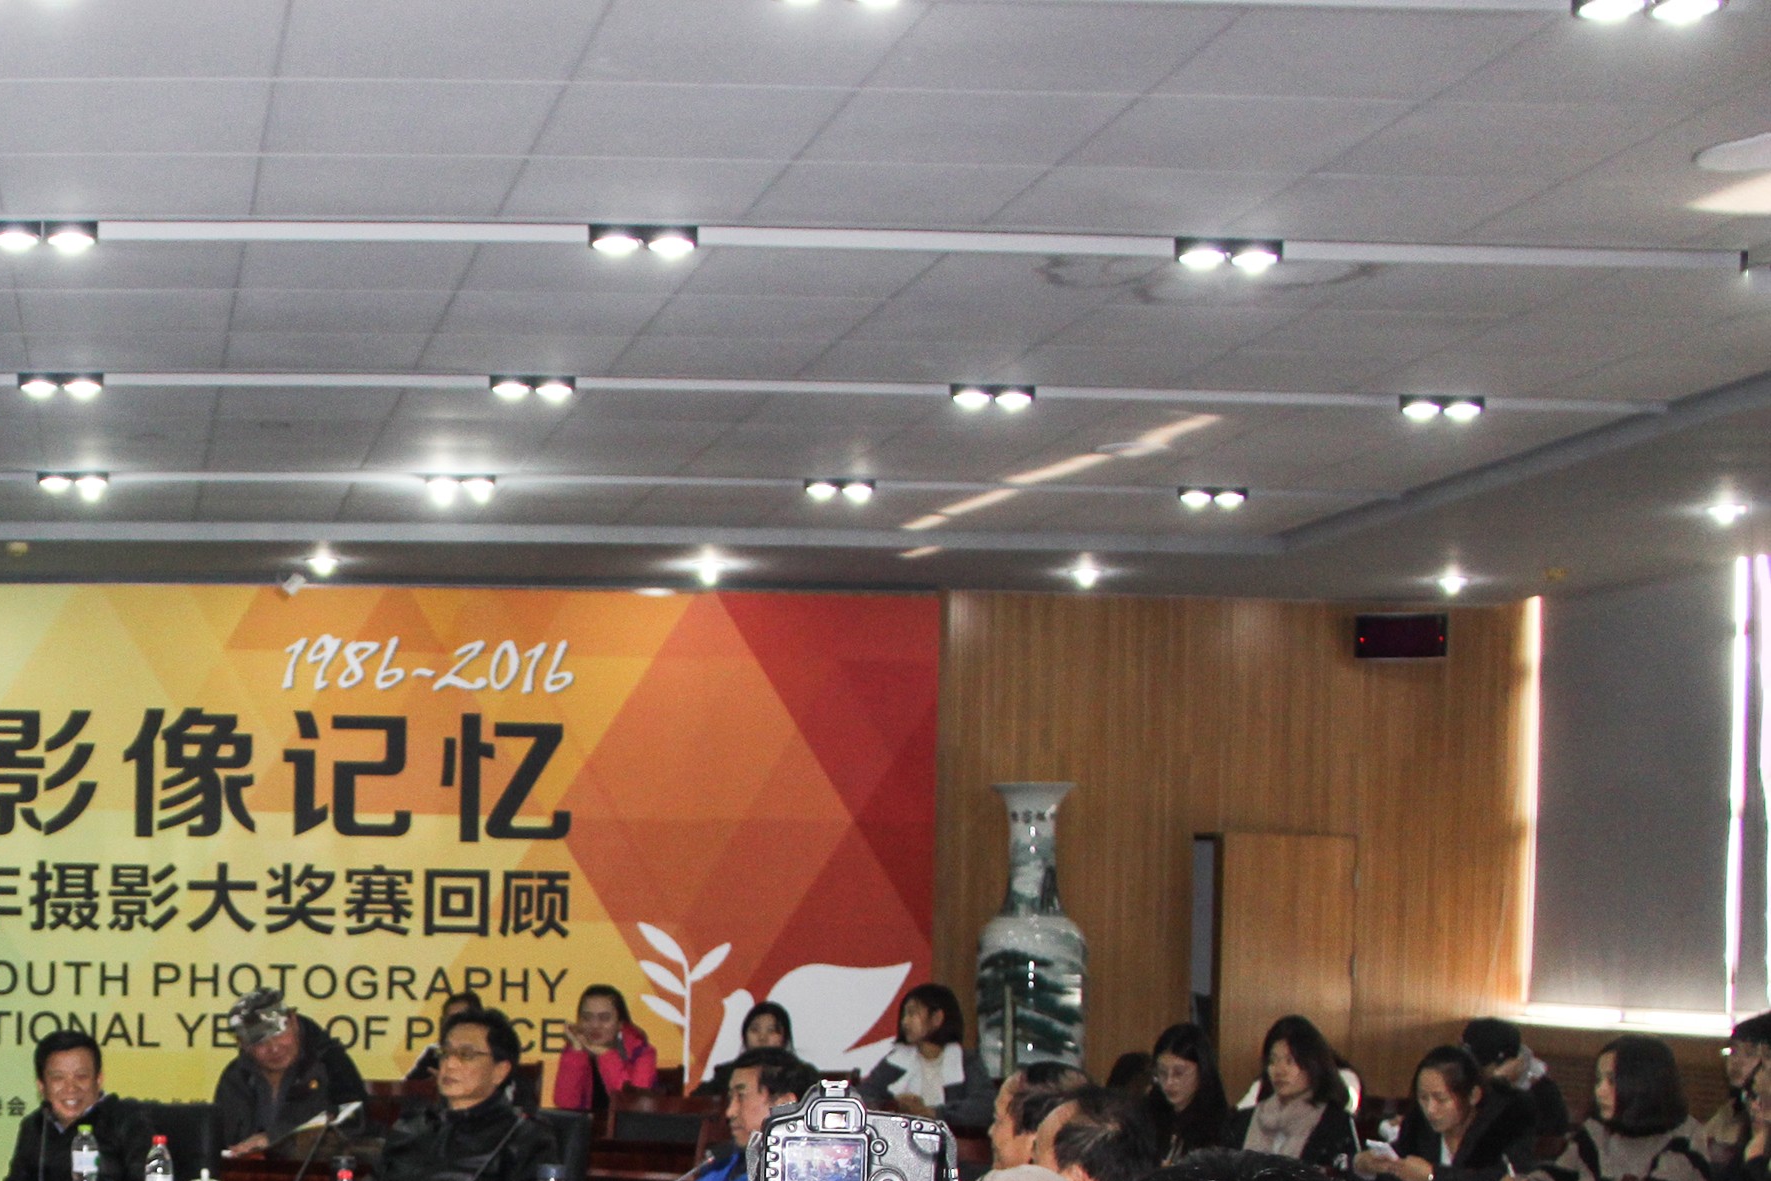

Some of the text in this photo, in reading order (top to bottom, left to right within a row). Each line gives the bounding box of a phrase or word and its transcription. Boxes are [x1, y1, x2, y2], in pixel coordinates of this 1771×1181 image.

[281, 634, 574, 694] 1986-2016
[153, 962, 569, 1002] PHOTOGRAPHY
[176, 1013, 237, 1047] YE
[328, 1015, 389, 1050] OF
[406, 1016, 565, 1052] PCE
